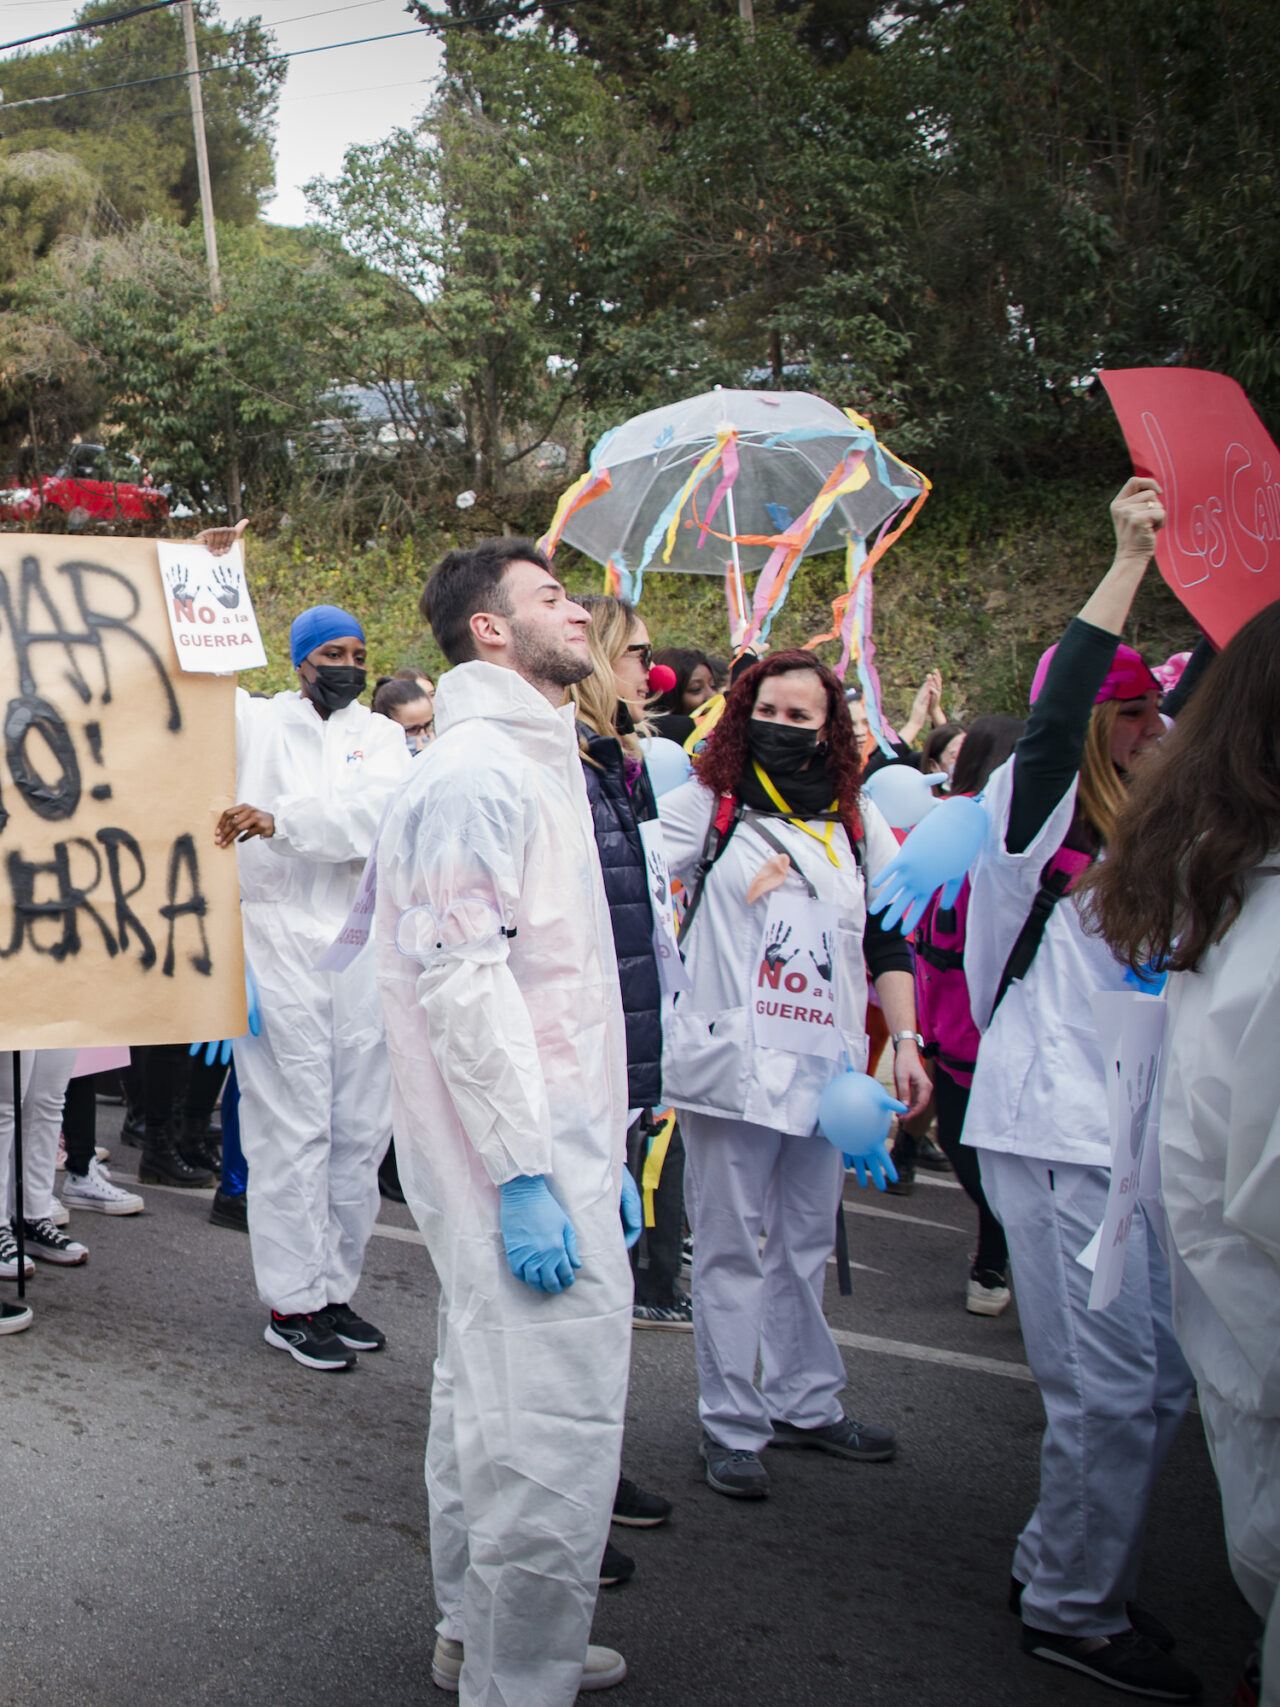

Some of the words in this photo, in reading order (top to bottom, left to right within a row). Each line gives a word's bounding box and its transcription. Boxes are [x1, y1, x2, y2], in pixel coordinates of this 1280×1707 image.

[222, 616, 230, 624] a
[234, 614, 248, 623] la
[178, 632, 253, 648] GUERRA
[812, 987, 823, 998] a
[756, 1000, 836, 1028] GUERRA
